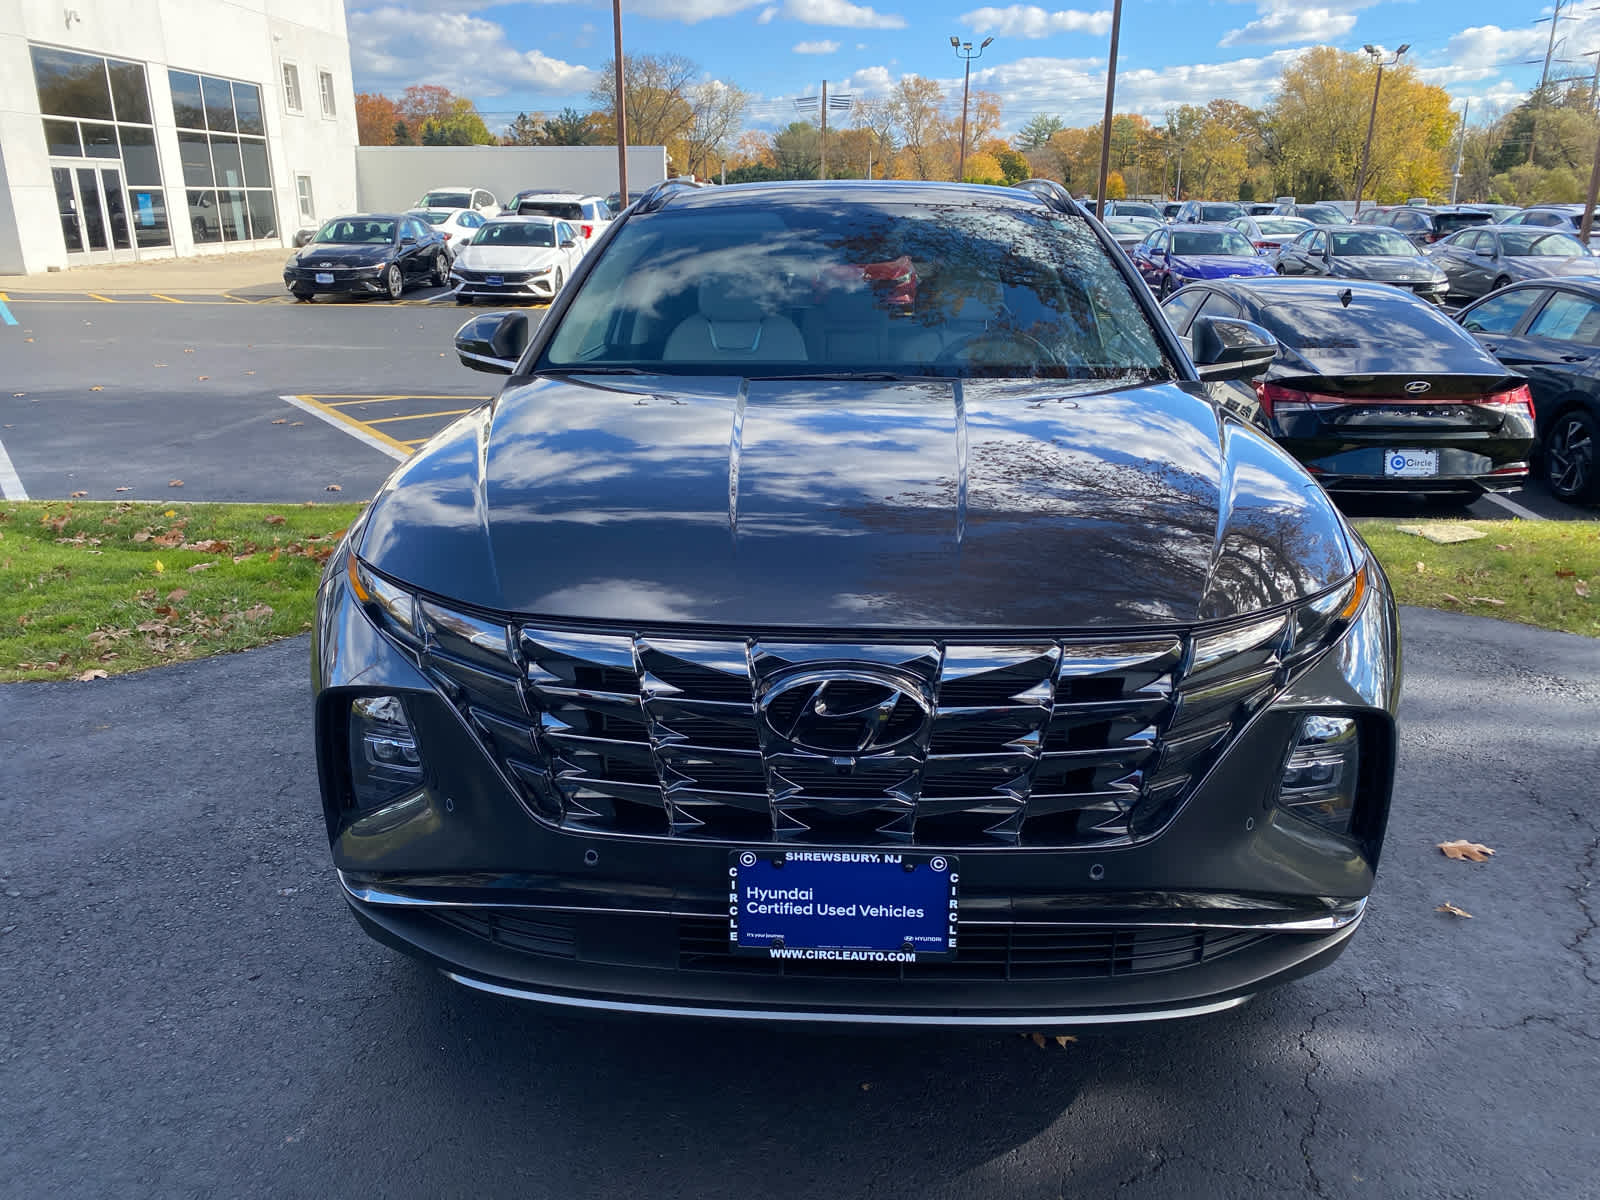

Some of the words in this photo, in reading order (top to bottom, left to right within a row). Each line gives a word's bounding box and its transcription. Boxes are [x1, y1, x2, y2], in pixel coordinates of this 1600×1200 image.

[1406, 459, 1432, 467] Circle
[785, 852, 881, 863] SHREWSBURY,
[884, 854, 903, 864] NJ
[746, 886, 814, 902] Hyundai
[729, 867, 738, 942] CIRCLE
[746, 901, 814, 916] Certified
[817, 903, 857, 917] Used
[859, 904, 925, 918] Vehicles
[948, 873, 959, 948] CIRCLE
[769, 949, 916, 963] WWW.CIRCLEAUTO.COM
